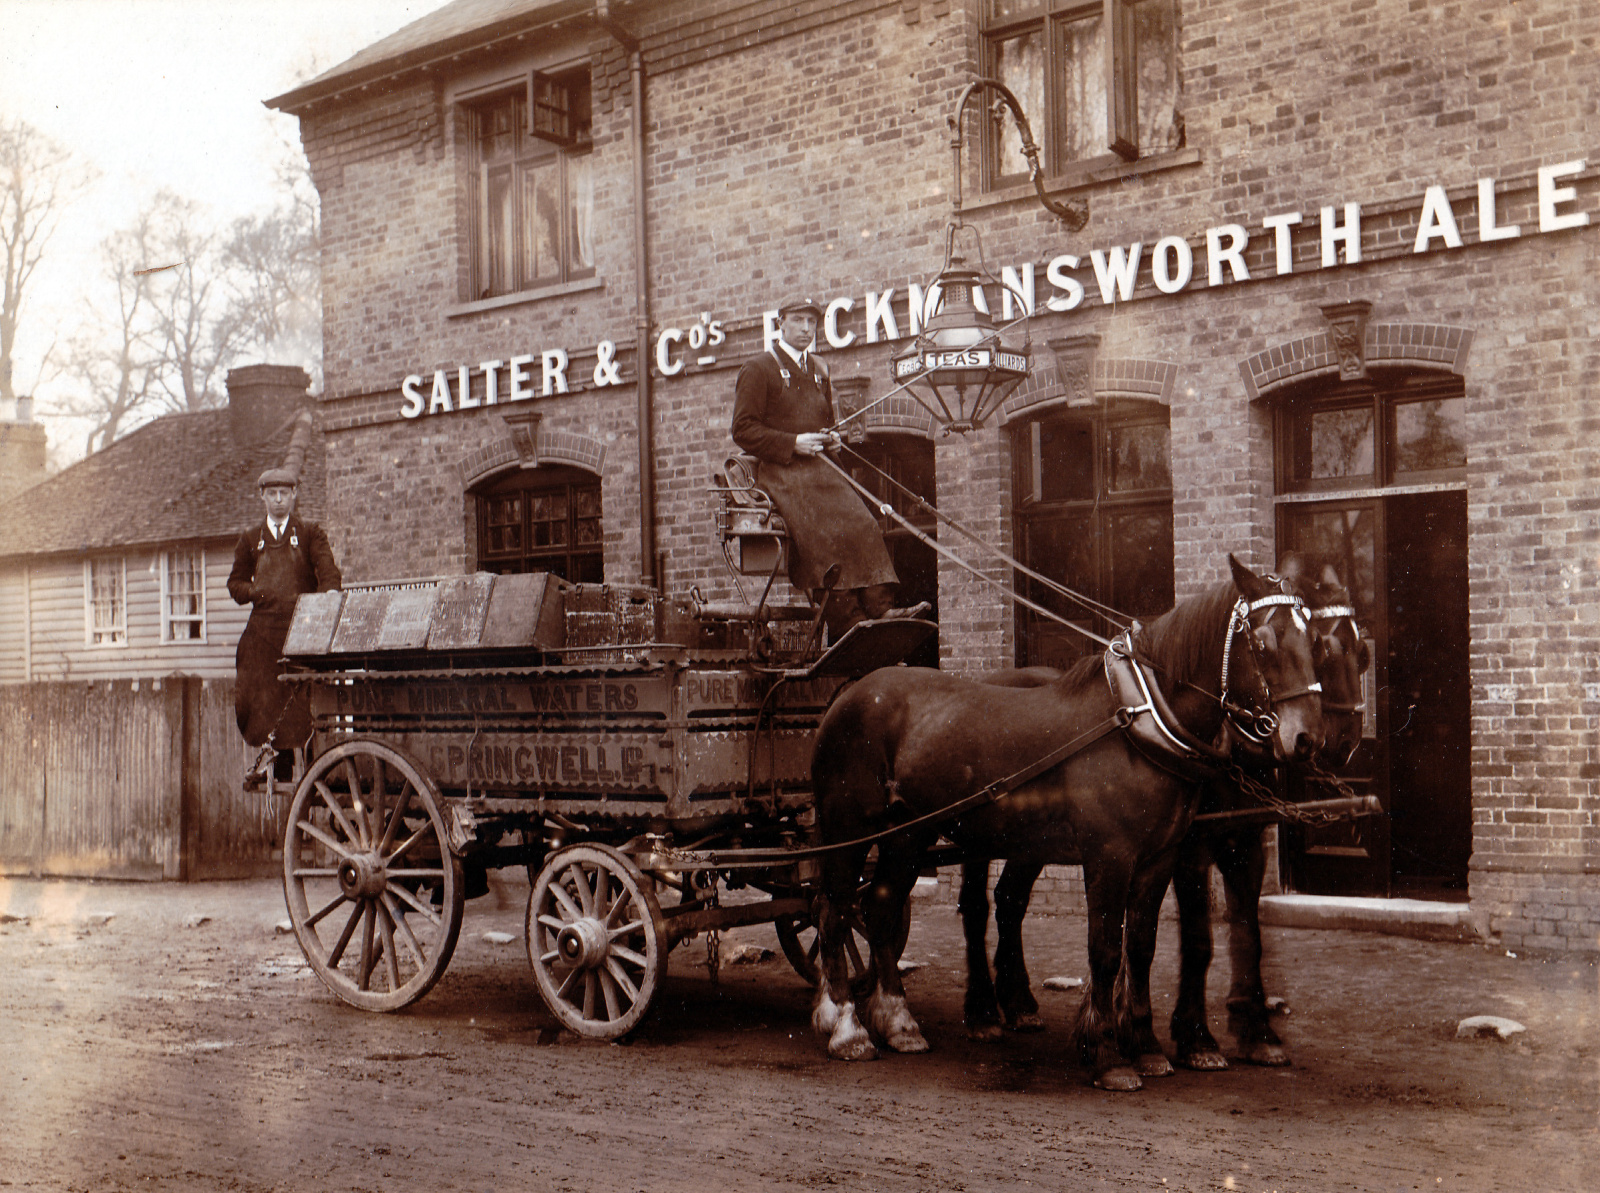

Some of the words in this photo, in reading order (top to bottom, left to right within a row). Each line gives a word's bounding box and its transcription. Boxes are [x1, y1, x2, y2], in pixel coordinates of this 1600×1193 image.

[400, 349, 569, 419] SALTER
[593, 340, 624, 387] &
[762, 201, 1362, 354] RCKMNSWORTH
[1413, 158, 1590, 253] ALE
[930, 352, 981, 367] TEAS
[993, 351, 1025, 371] ILLIARDS
[337, 684, 396, 713] PURE
[408, 684, 517, 712] MINERAL
[530, 682, 639, 711] WATERS
[687, 678, 734, 704] PURE
[736, 676, 810, 704] MINRAL
